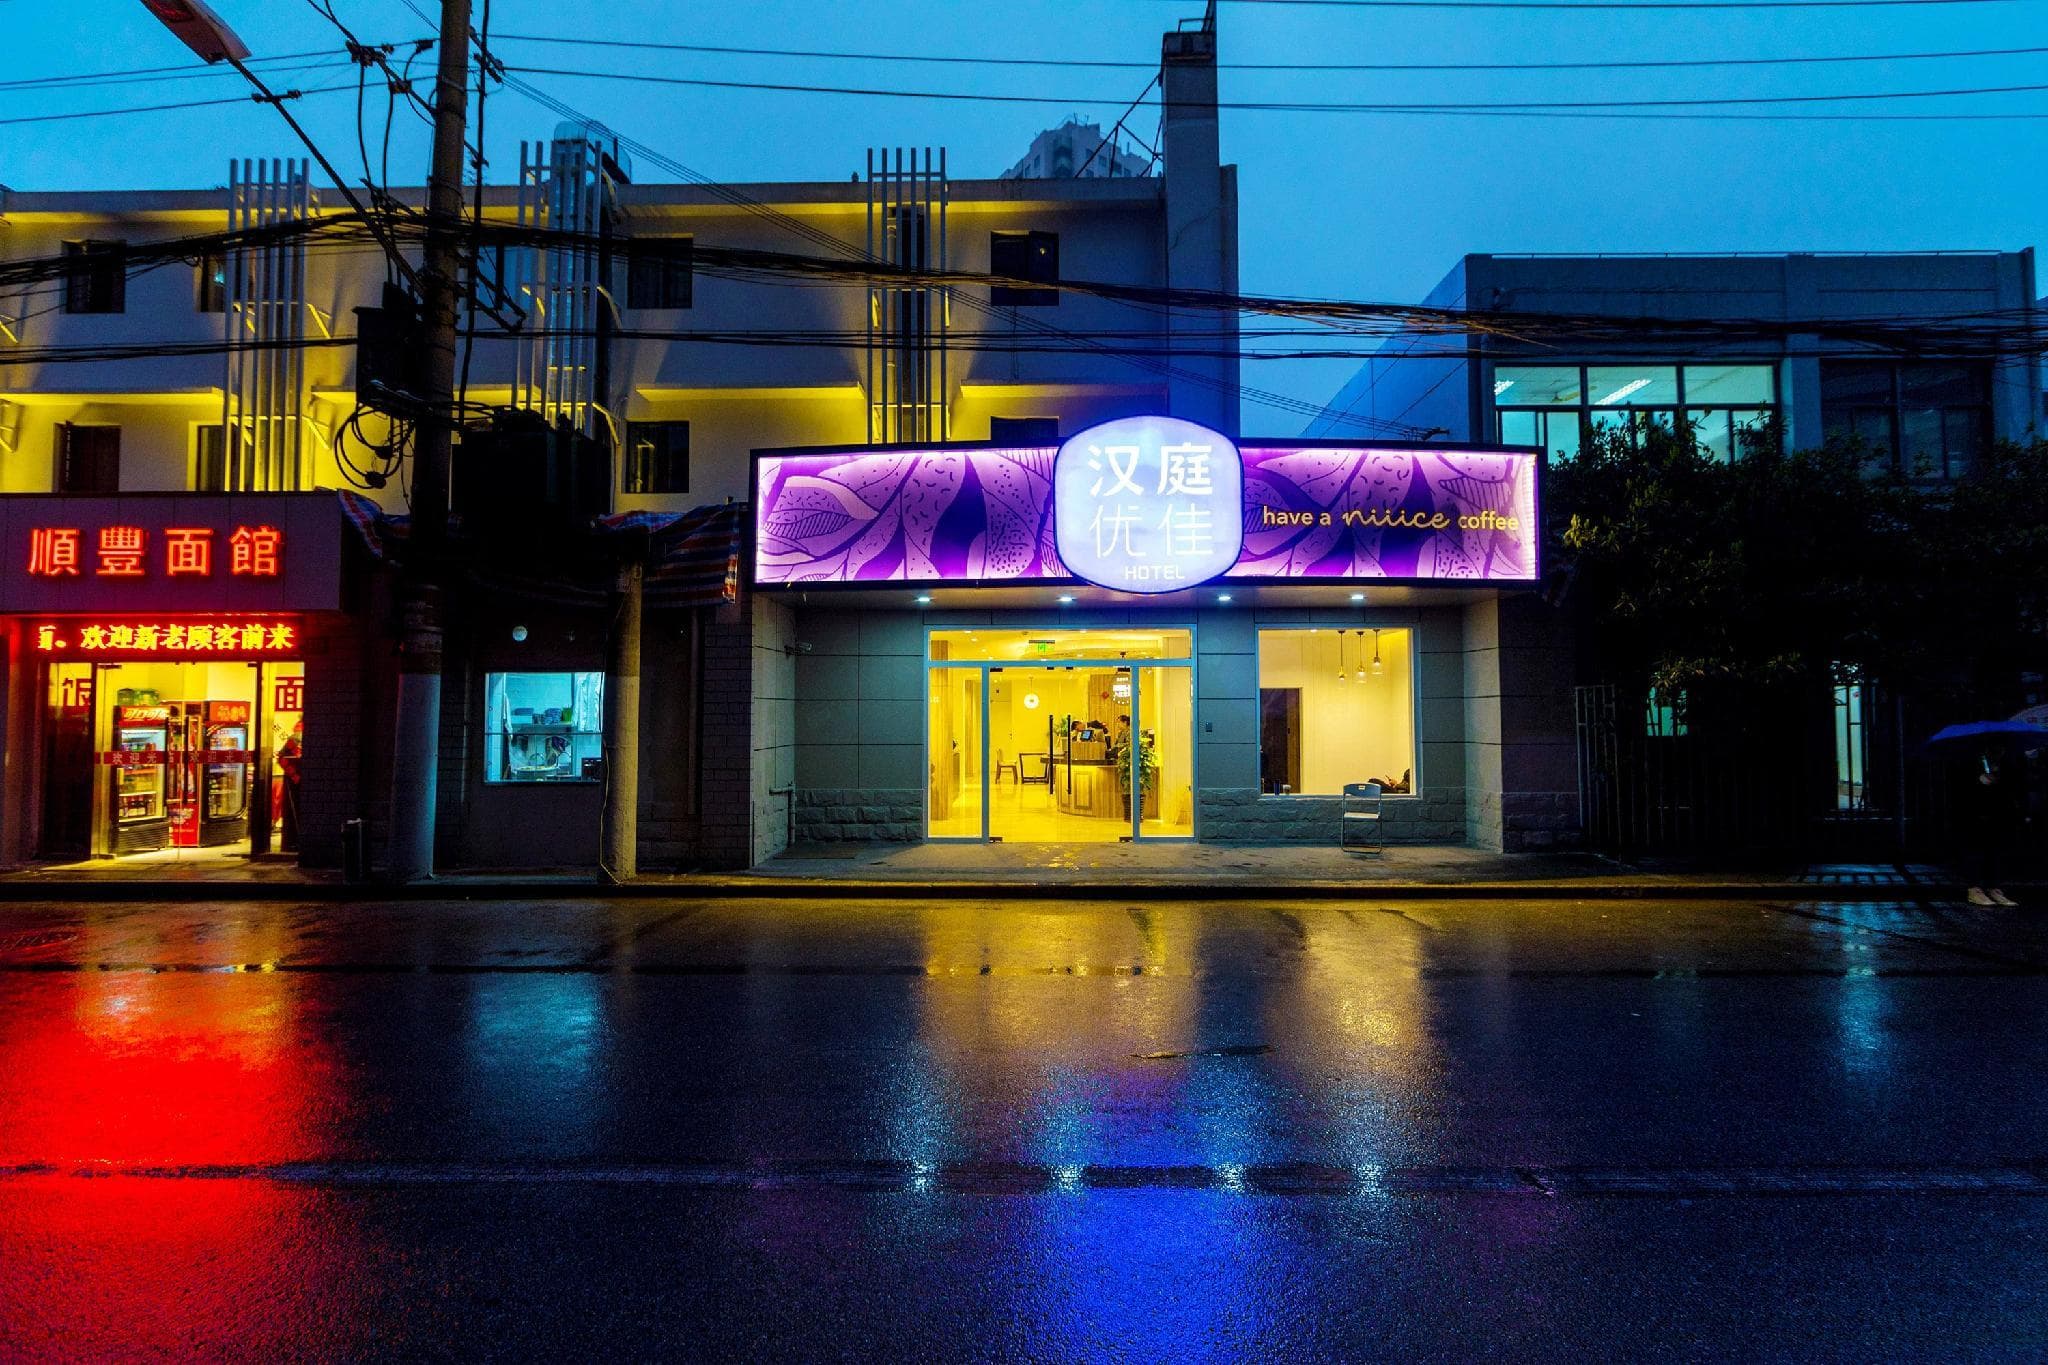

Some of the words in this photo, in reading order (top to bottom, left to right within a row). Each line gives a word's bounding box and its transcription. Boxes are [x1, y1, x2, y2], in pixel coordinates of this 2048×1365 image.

[1087, 442, 1213, 497] 汉庭
[1088, 502, 1214, 559] 优佳
[1262, 505, 1314, 526] have
[1319, 512, 1332, 526] a
[1458, 510, 1520, 531] coffee
[27, 525, 281, 577] 順豐面館
[1124, 564, 1185, 581] HOTEL
[274, 676, 304, 712] 面
